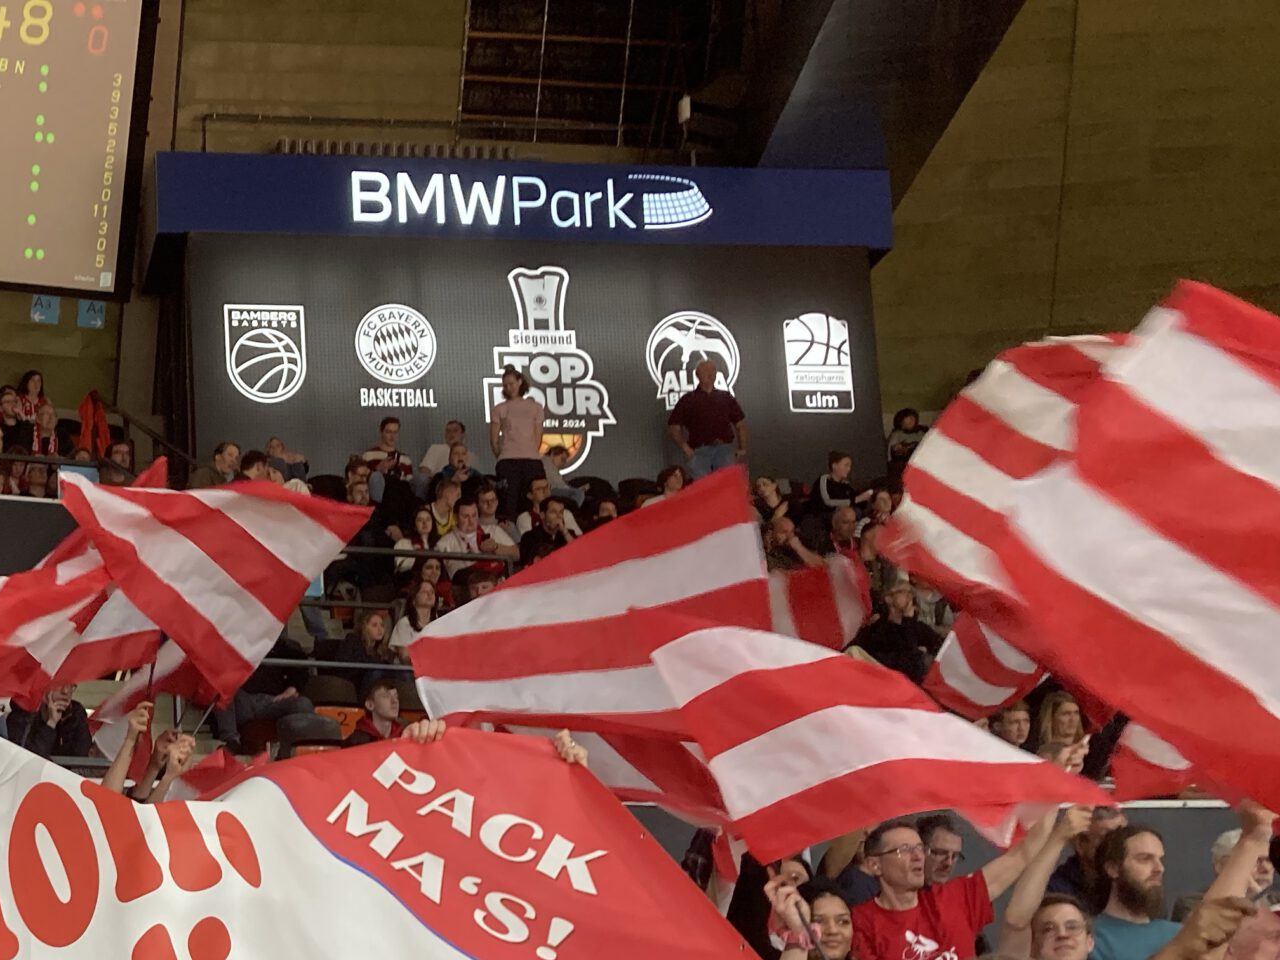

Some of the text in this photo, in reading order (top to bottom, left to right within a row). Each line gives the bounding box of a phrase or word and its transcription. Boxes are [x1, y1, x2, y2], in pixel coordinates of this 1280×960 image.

[87, 25, 109, 55] 0
[113, 73, 122, 87] 3
[112, 89, 121, 104] 9
[110, 105, 119, 120] 3
[108, 123, 118, 137] 5
[106, 139, 116, 153] 2
[105, 155, 114, 170] 2
[104, 171, 113, 185] 5
[102, 188, 111, 202] 0
[93, 204, 107, 219] 11
[98, 221, 108, 235] 3
[97, 237, 106, 251] 0
[95, 254, 105, 268] 5
[231, 310, 297, 320] BAMBERG
[363, 311, 428, 338] FC BAYERN
[513, 333, 572, 347] siegmund
[504, 355, 585, 384] TOP
[661, 370, 730, 394] ALA
[795, 374, 845, 384] ratiopharm
[360, 388, 438, 407] BASKETBALL
[805, 392, 838, 408] ulm
[563, 419, 586, 428] 2024
[337, 711, 349, 726] 2
[371, 751, 608, 897] PACK
